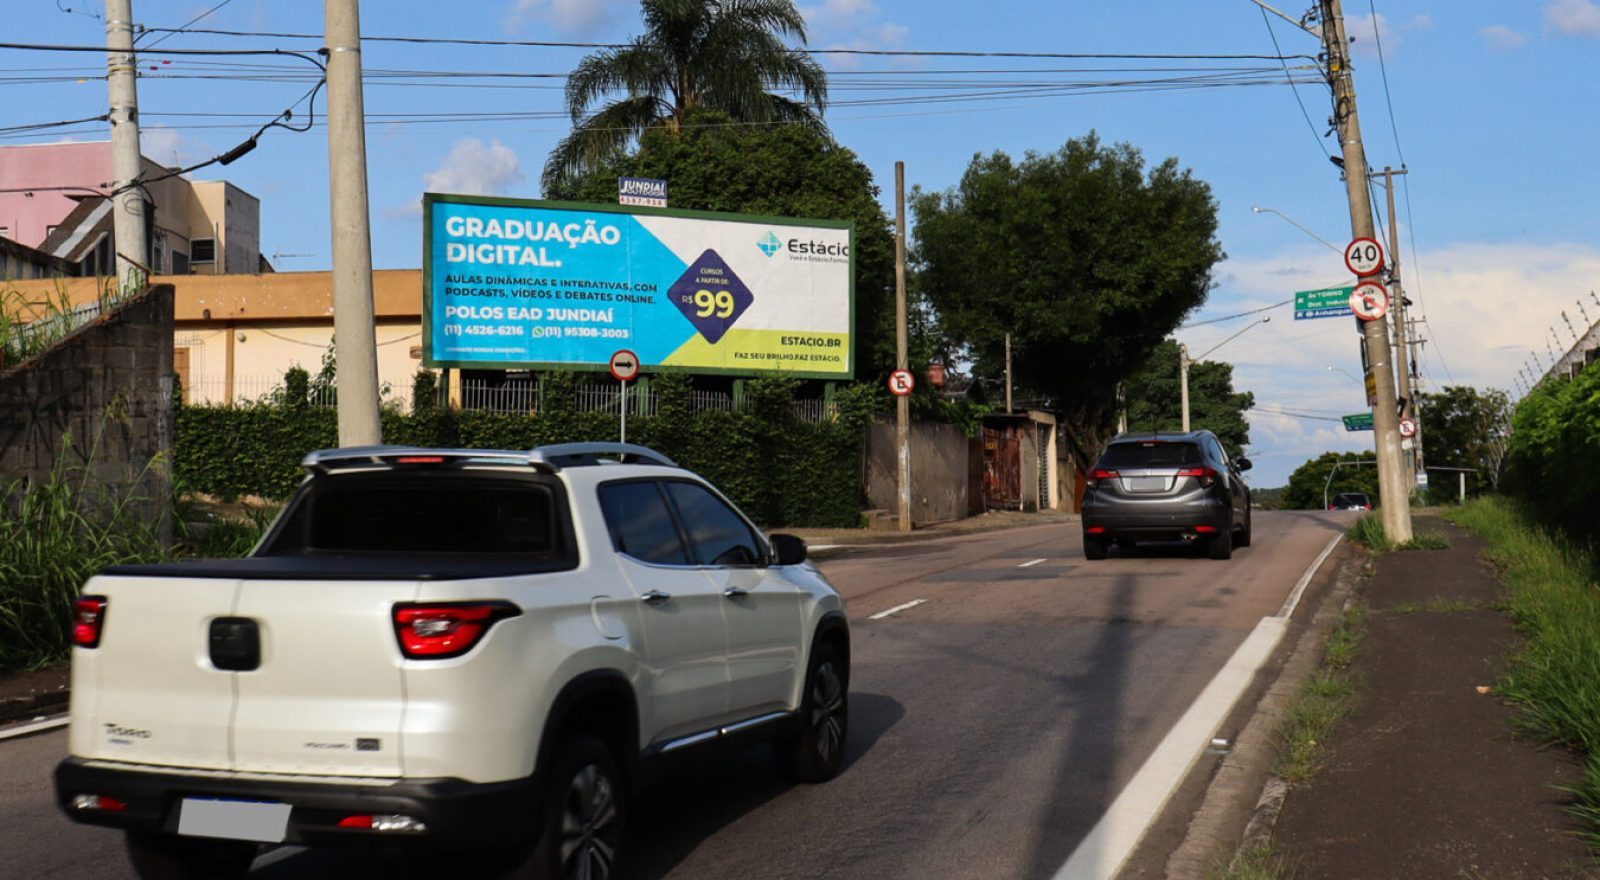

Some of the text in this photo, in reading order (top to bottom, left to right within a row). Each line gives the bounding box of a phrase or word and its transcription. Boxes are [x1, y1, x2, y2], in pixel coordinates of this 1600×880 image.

[445, 216, 621, 248] GRADUAÇÃO
[446, 243, 562, 267] DIGITAL.
[1350, 245, 1377, 262] 40
[700, 267, 724, 276] CURSOS
[445, 274, 482, 284] AULAS
[550, 279, 557, 287] E
[633, 283, 658, 293] COM
[695, 276, 700, 284] A
[701, 277, 720, 285] PARTIR
[445, 287, 657, 304] PODCASTS, VÍDEOS E DEBATES ONLINE.
[682, 289, 734, 318] R$ 99
[445, 305, 614, 323] POLOS EAD JUNDIAÍ
[444, 324, 524, 336] (11) 4526-6216
[545, 327, 630, 339] (11) 95308-3003
[780, 336, 841, 348] ESTACIO.BR
[734, 351, 749, 360] FAZ
[750, 352, 765, 360] SEU
